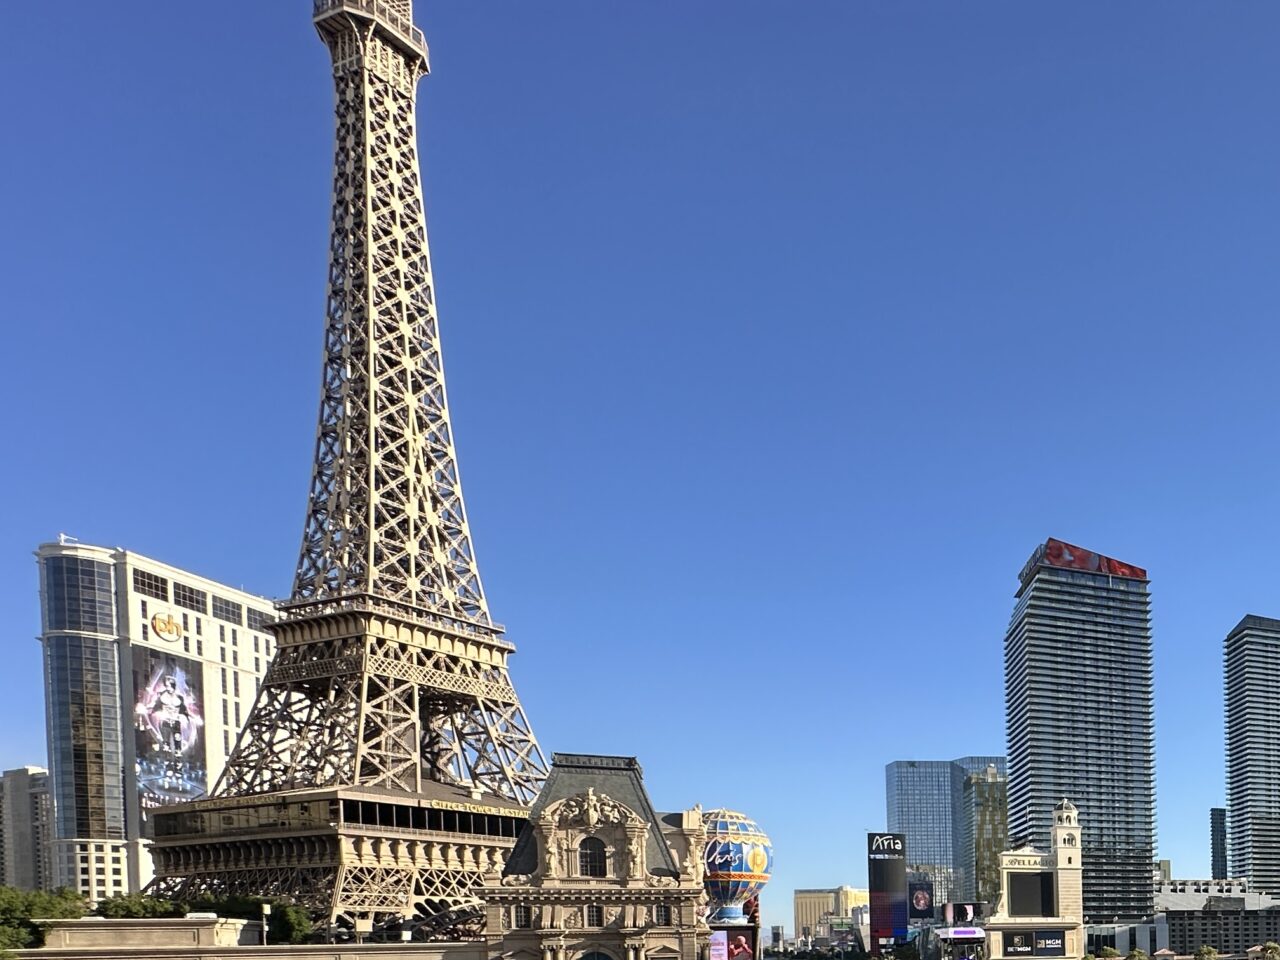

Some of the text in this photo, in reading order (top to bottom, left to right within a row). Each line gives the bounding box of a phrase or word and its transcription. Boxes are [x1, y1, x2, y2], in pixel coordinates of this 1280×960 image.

[464, 803, 497, 814] TOWER
[499, 807, 529, 818] RESTAU
[872, 835, 903, 850] Aria
[704, 836, 743, 876] Paris
